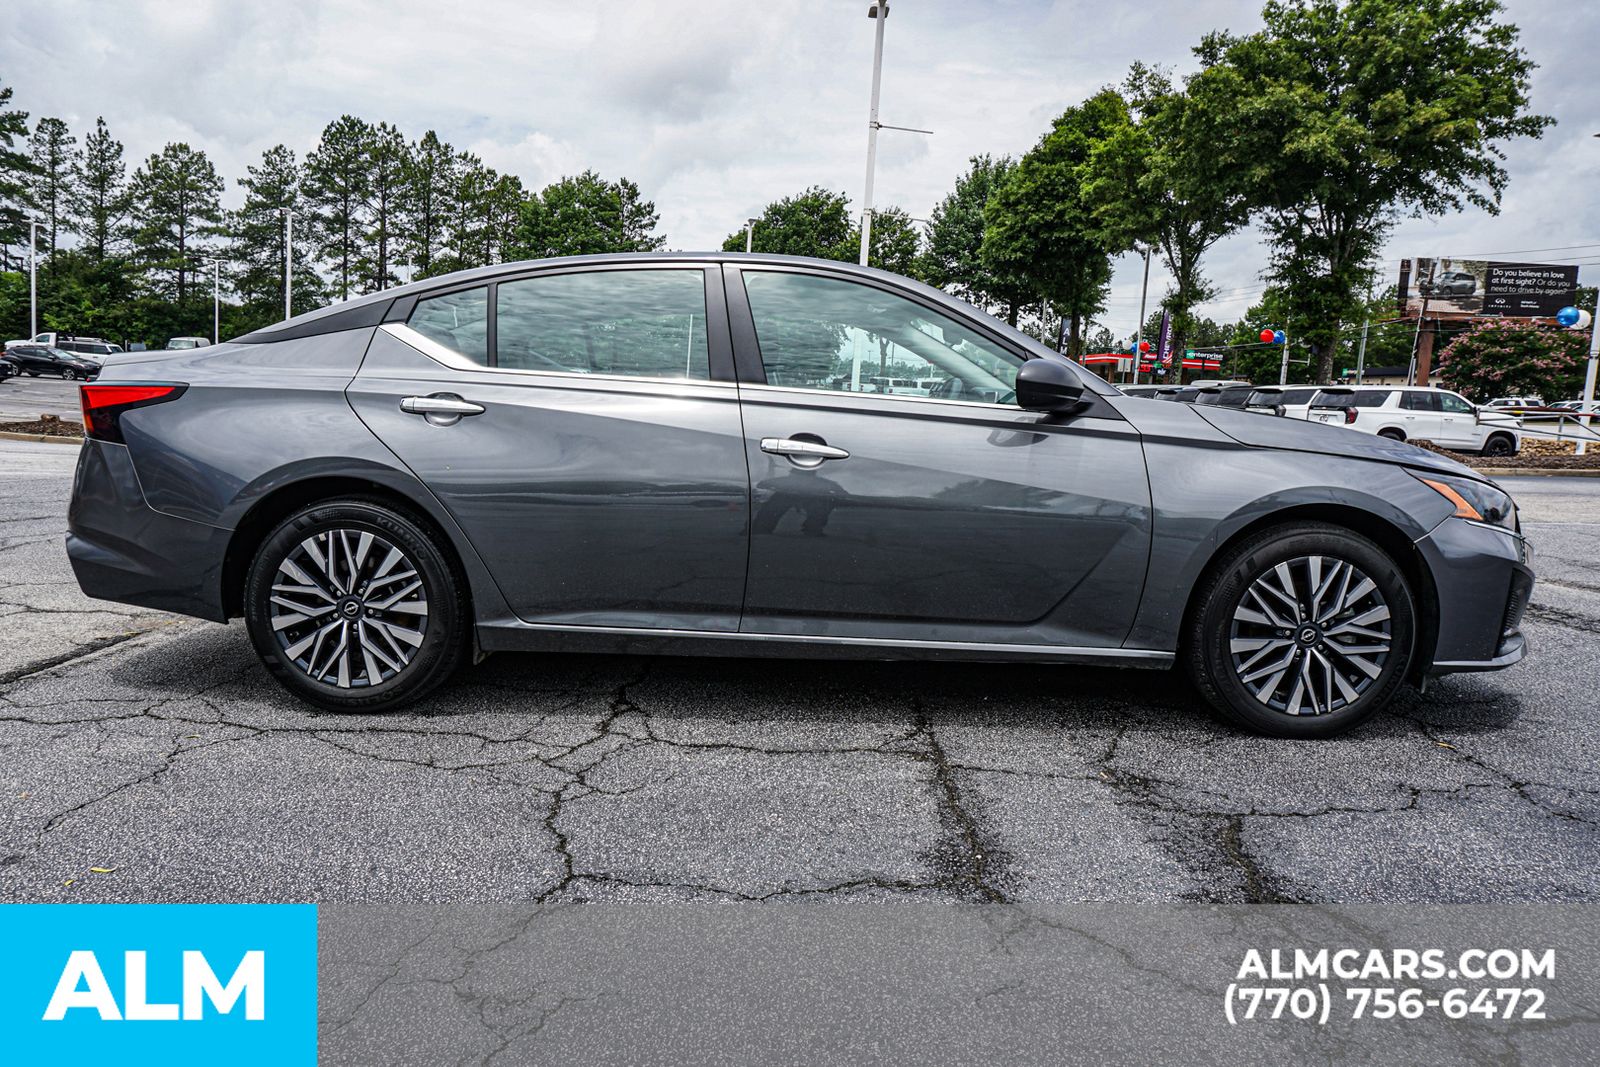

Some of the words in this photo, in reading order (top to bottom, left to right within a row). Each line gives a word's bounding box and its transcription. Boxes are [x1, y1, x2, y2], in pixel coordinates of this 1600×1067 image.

[1516, 278, 1536, 286] sight?
[1060, 328, 1070, 354] ALM
[1187, 352, 1223, 360] enterprise
